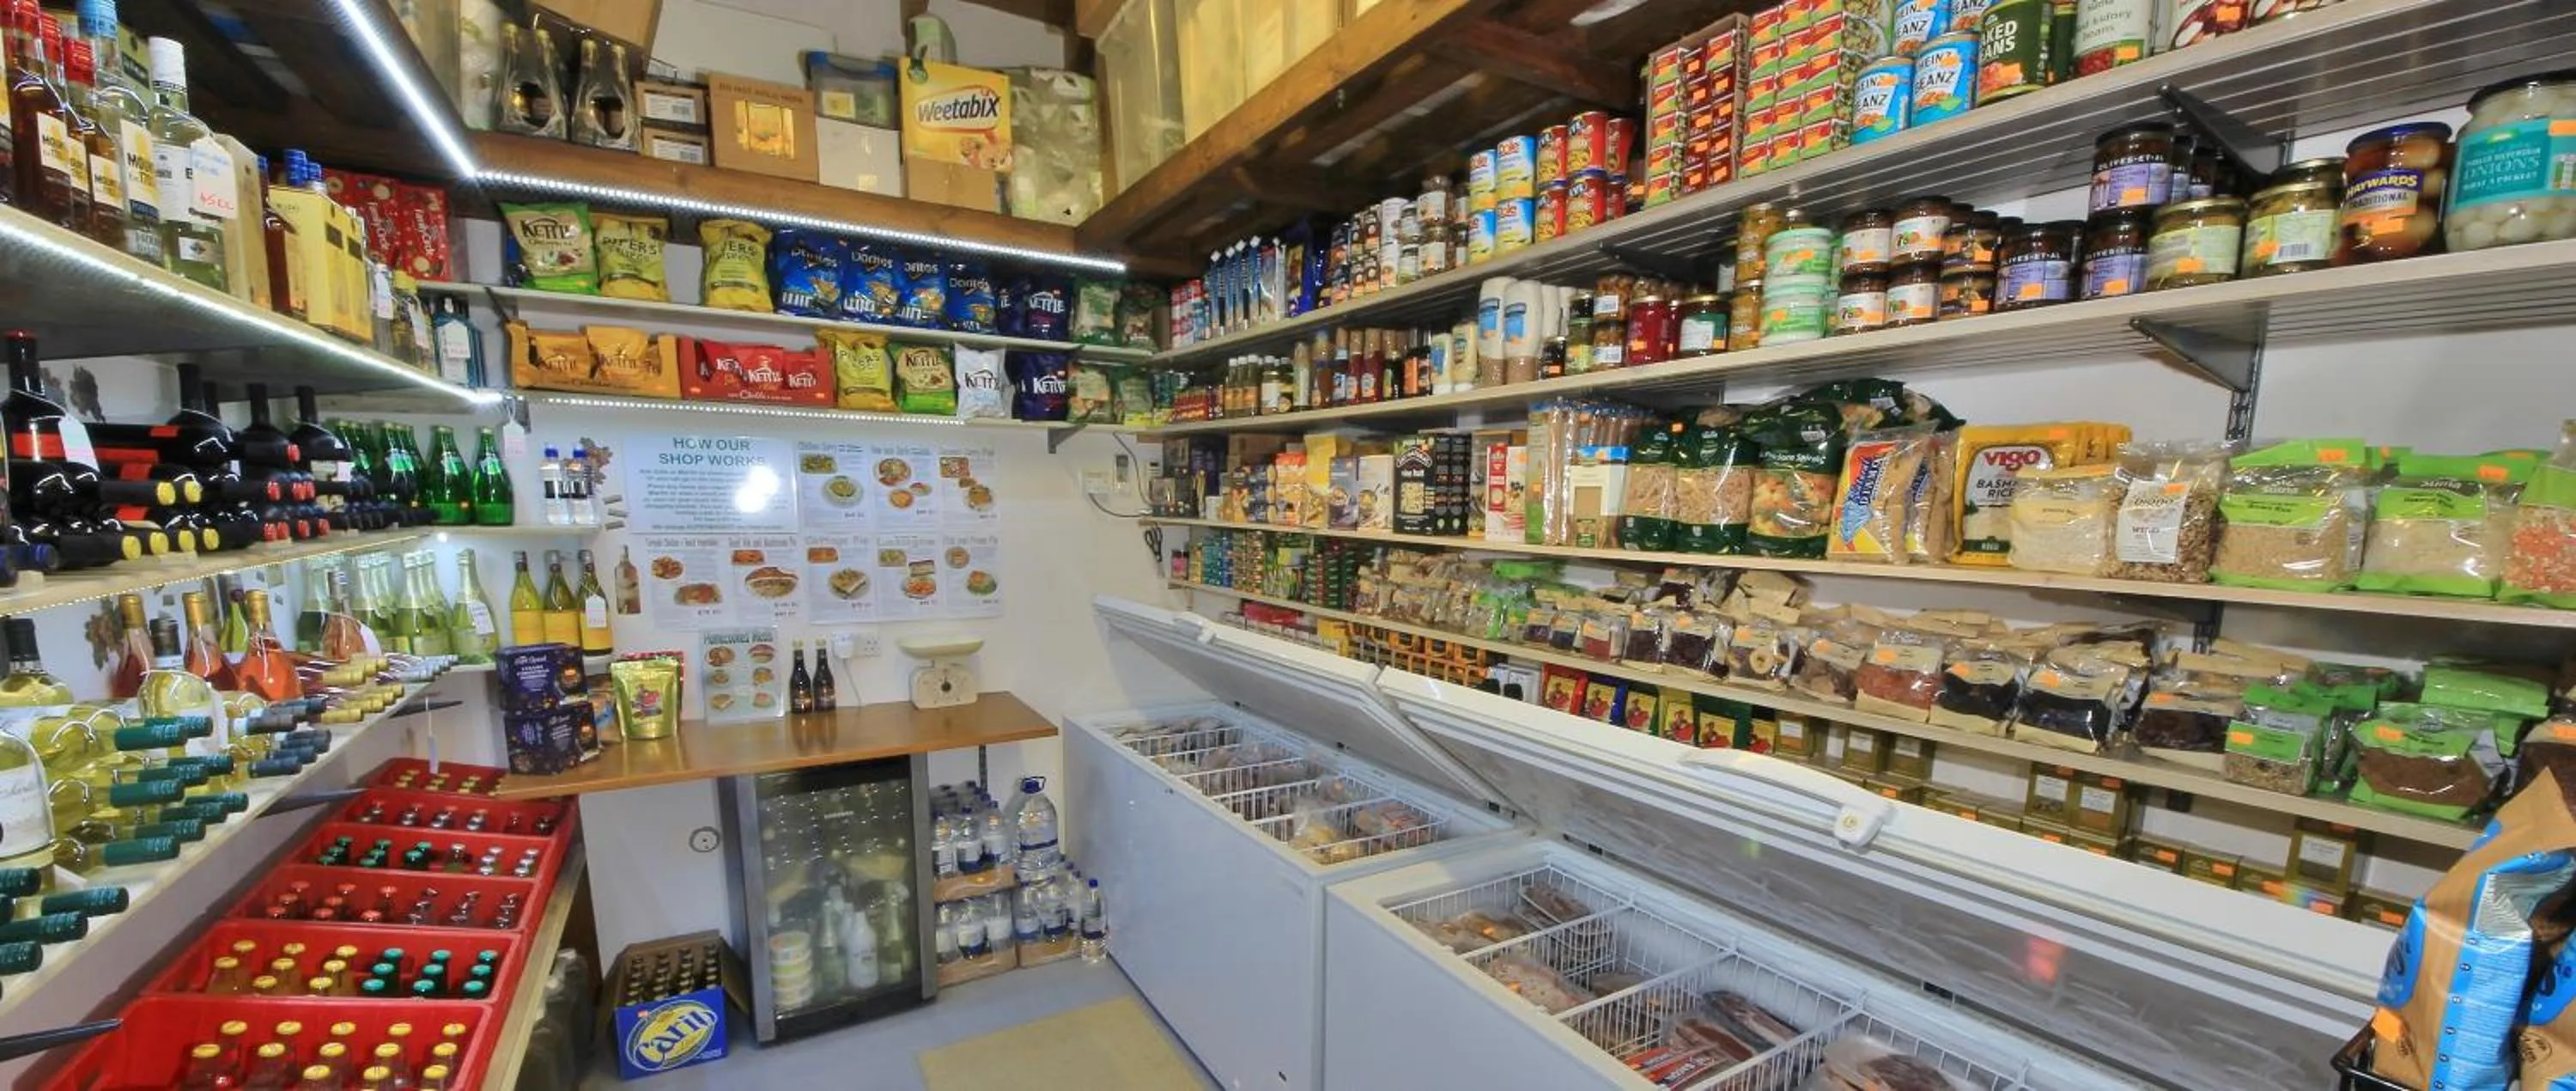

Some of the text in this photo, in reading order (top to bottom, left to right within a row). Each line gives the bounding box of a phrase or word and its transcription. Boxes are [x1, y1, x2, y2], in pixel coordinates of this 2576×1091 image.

[918, 92, 1001, 122] Weetabix
[2347, 174, 2418, 198] HAYWARDS
[672, 437, 750, 451] HOW OUR
[659, 453, 704, 466] SHOP
[1977, 478, 2017, 489] BASM
